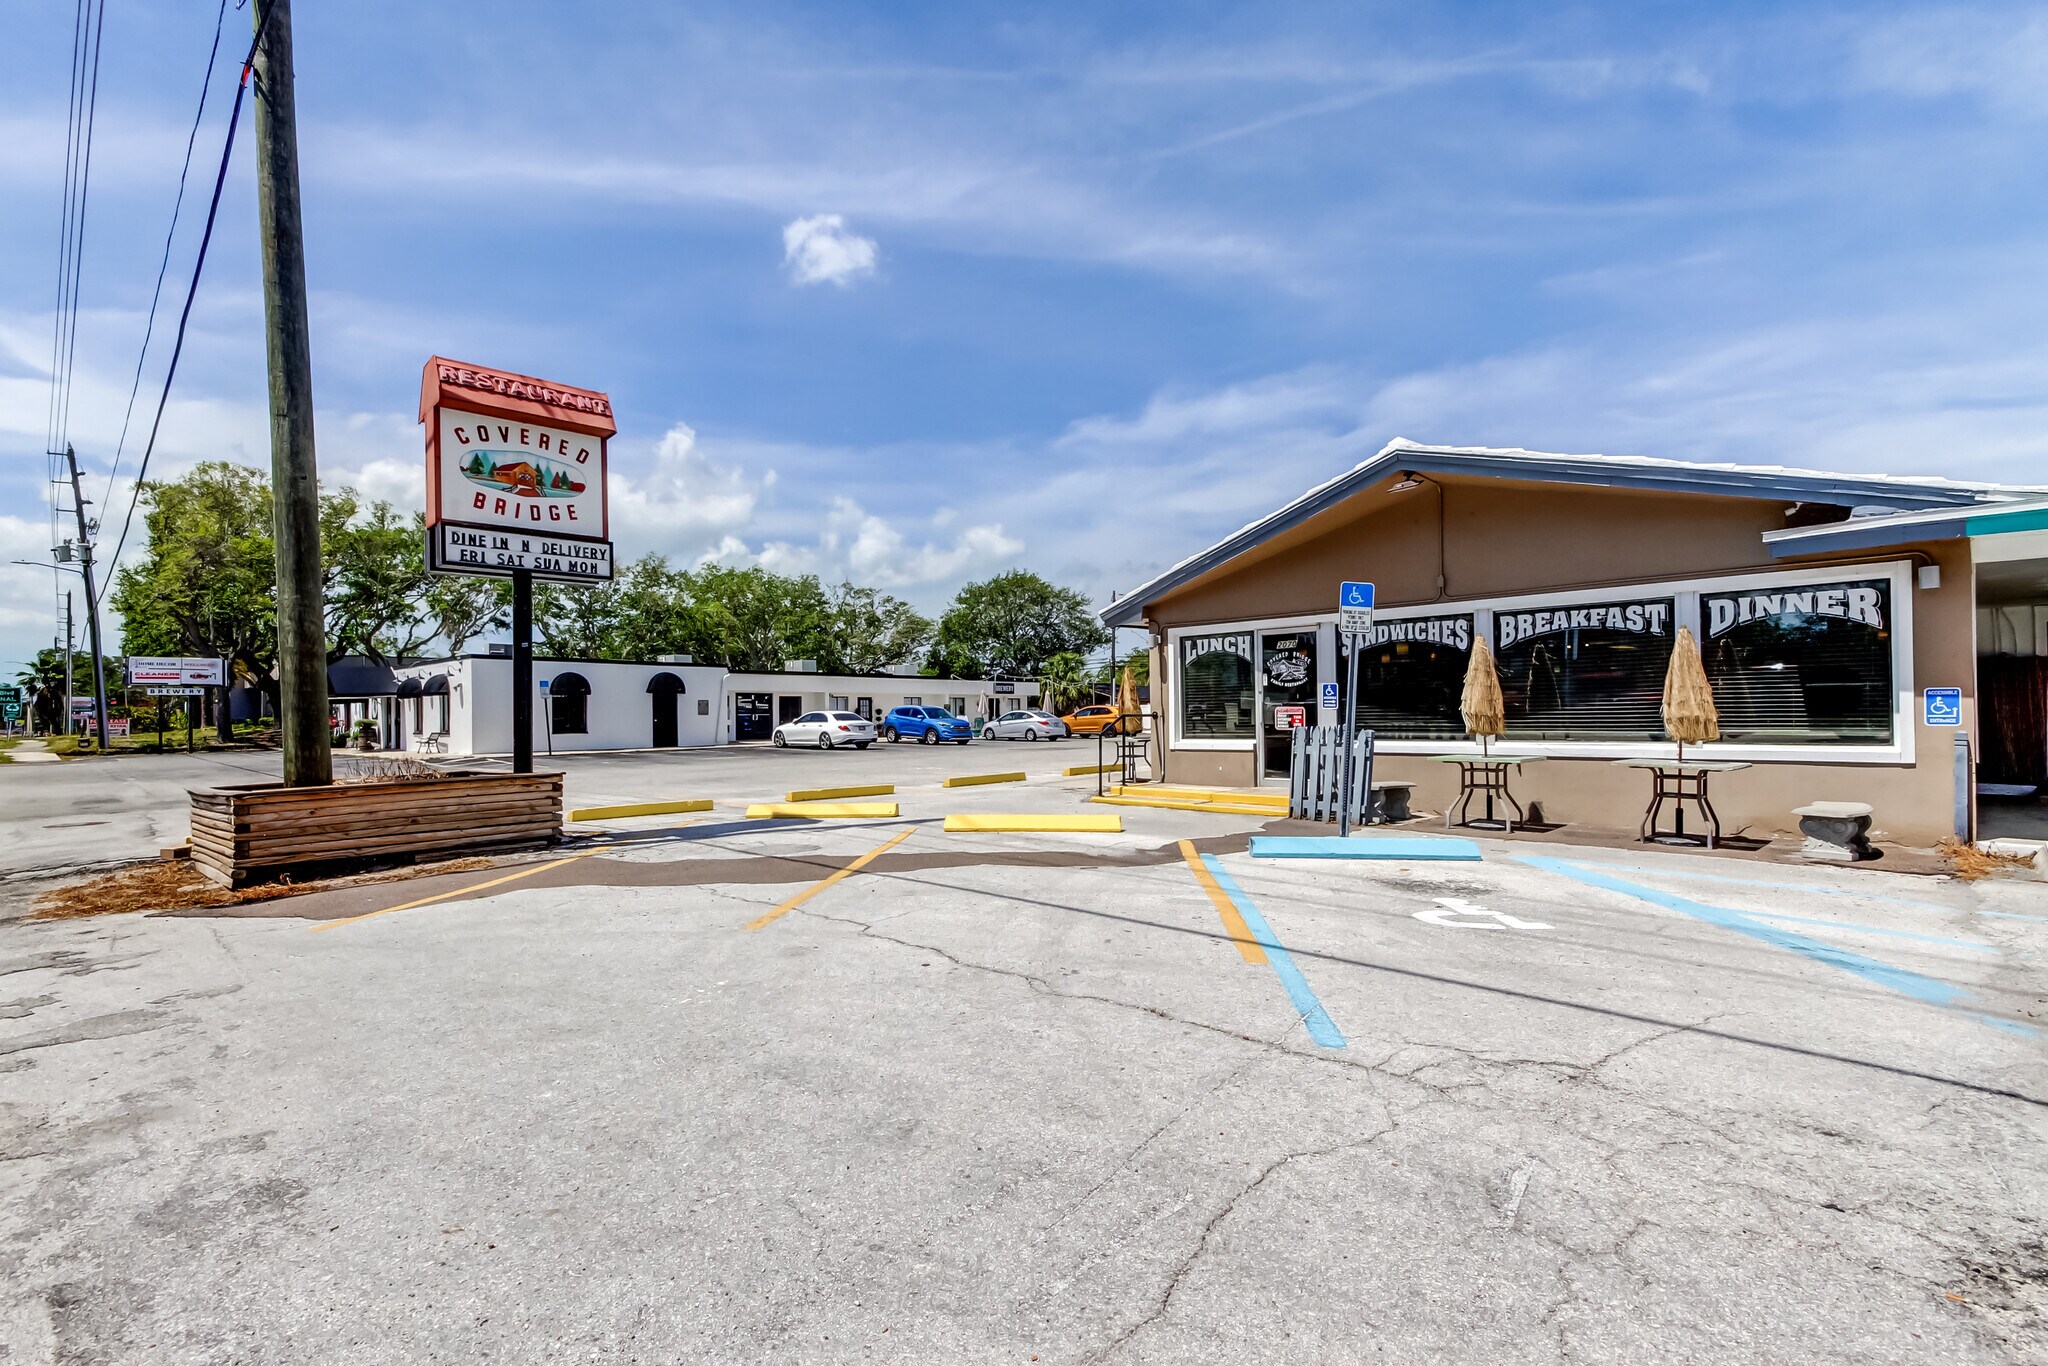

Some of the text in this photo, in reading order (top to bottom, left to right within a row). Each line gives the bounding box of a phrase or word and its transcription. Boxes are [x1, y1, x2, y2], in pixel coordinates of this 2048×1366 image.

[439, 365, 609, 414] RESTAURANT
[454, 425, 590, 465] COVERED
[473, 491, 578, 521] BRIDGE
[450, 531, 608, 561] DINE IN N DELIVERY
[497, 553, 525, 567] SAT
[569, 561, 599, 574] MON
[1500, 603, 1668, 649] BREAKFAST
[1708, 587, 1883, 639] DINNER
[1185, 636, 1252, 667] LUNCH
[1267, 651, 1289, 667] COVERED
[1277, 640, 1297, 649] 2070
